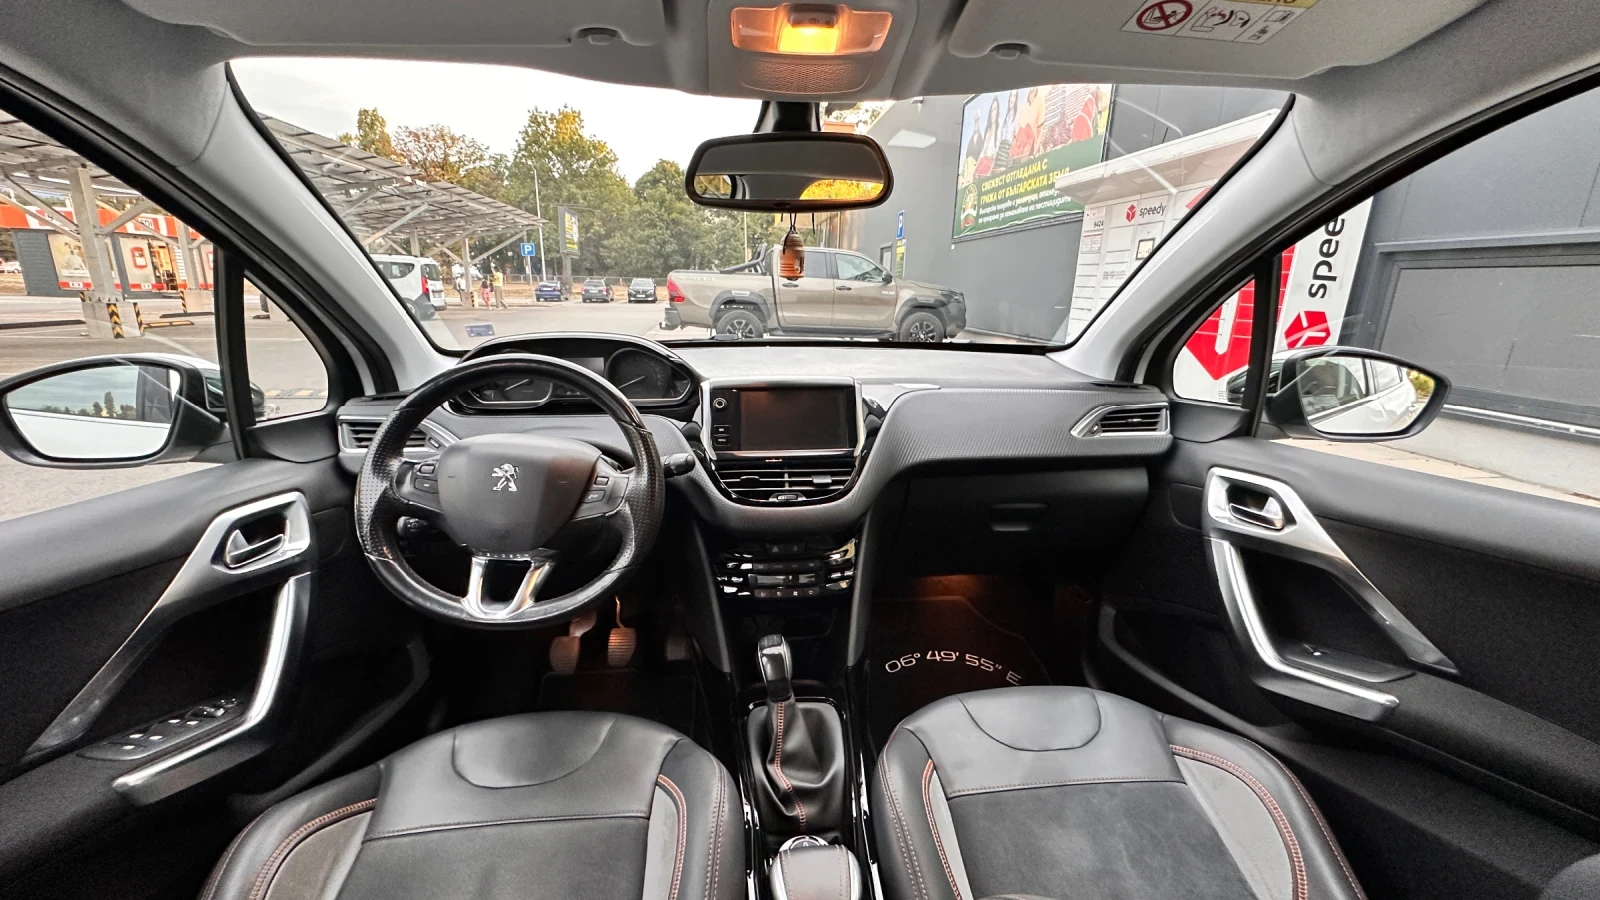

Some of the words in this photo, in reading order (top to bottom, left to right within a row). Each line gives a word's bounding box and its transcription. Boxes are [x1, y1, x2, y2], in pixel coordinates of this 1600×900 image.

[982, 175, 1005, 192] СВЕЖЕСТ
[1005, 161, 1041, 183] ОТГЛЕДАНА
[1042, 158, 1048, 170] С
[998, 188, 1006, 200] ОТ
[1005, 174, 1048, 198] БЪЛГАРСКАТА
[1139, 203, 1167, 218] speedy
[1308, 216, 1345, 299] spee
[1005, 670, 1022, 686] E
